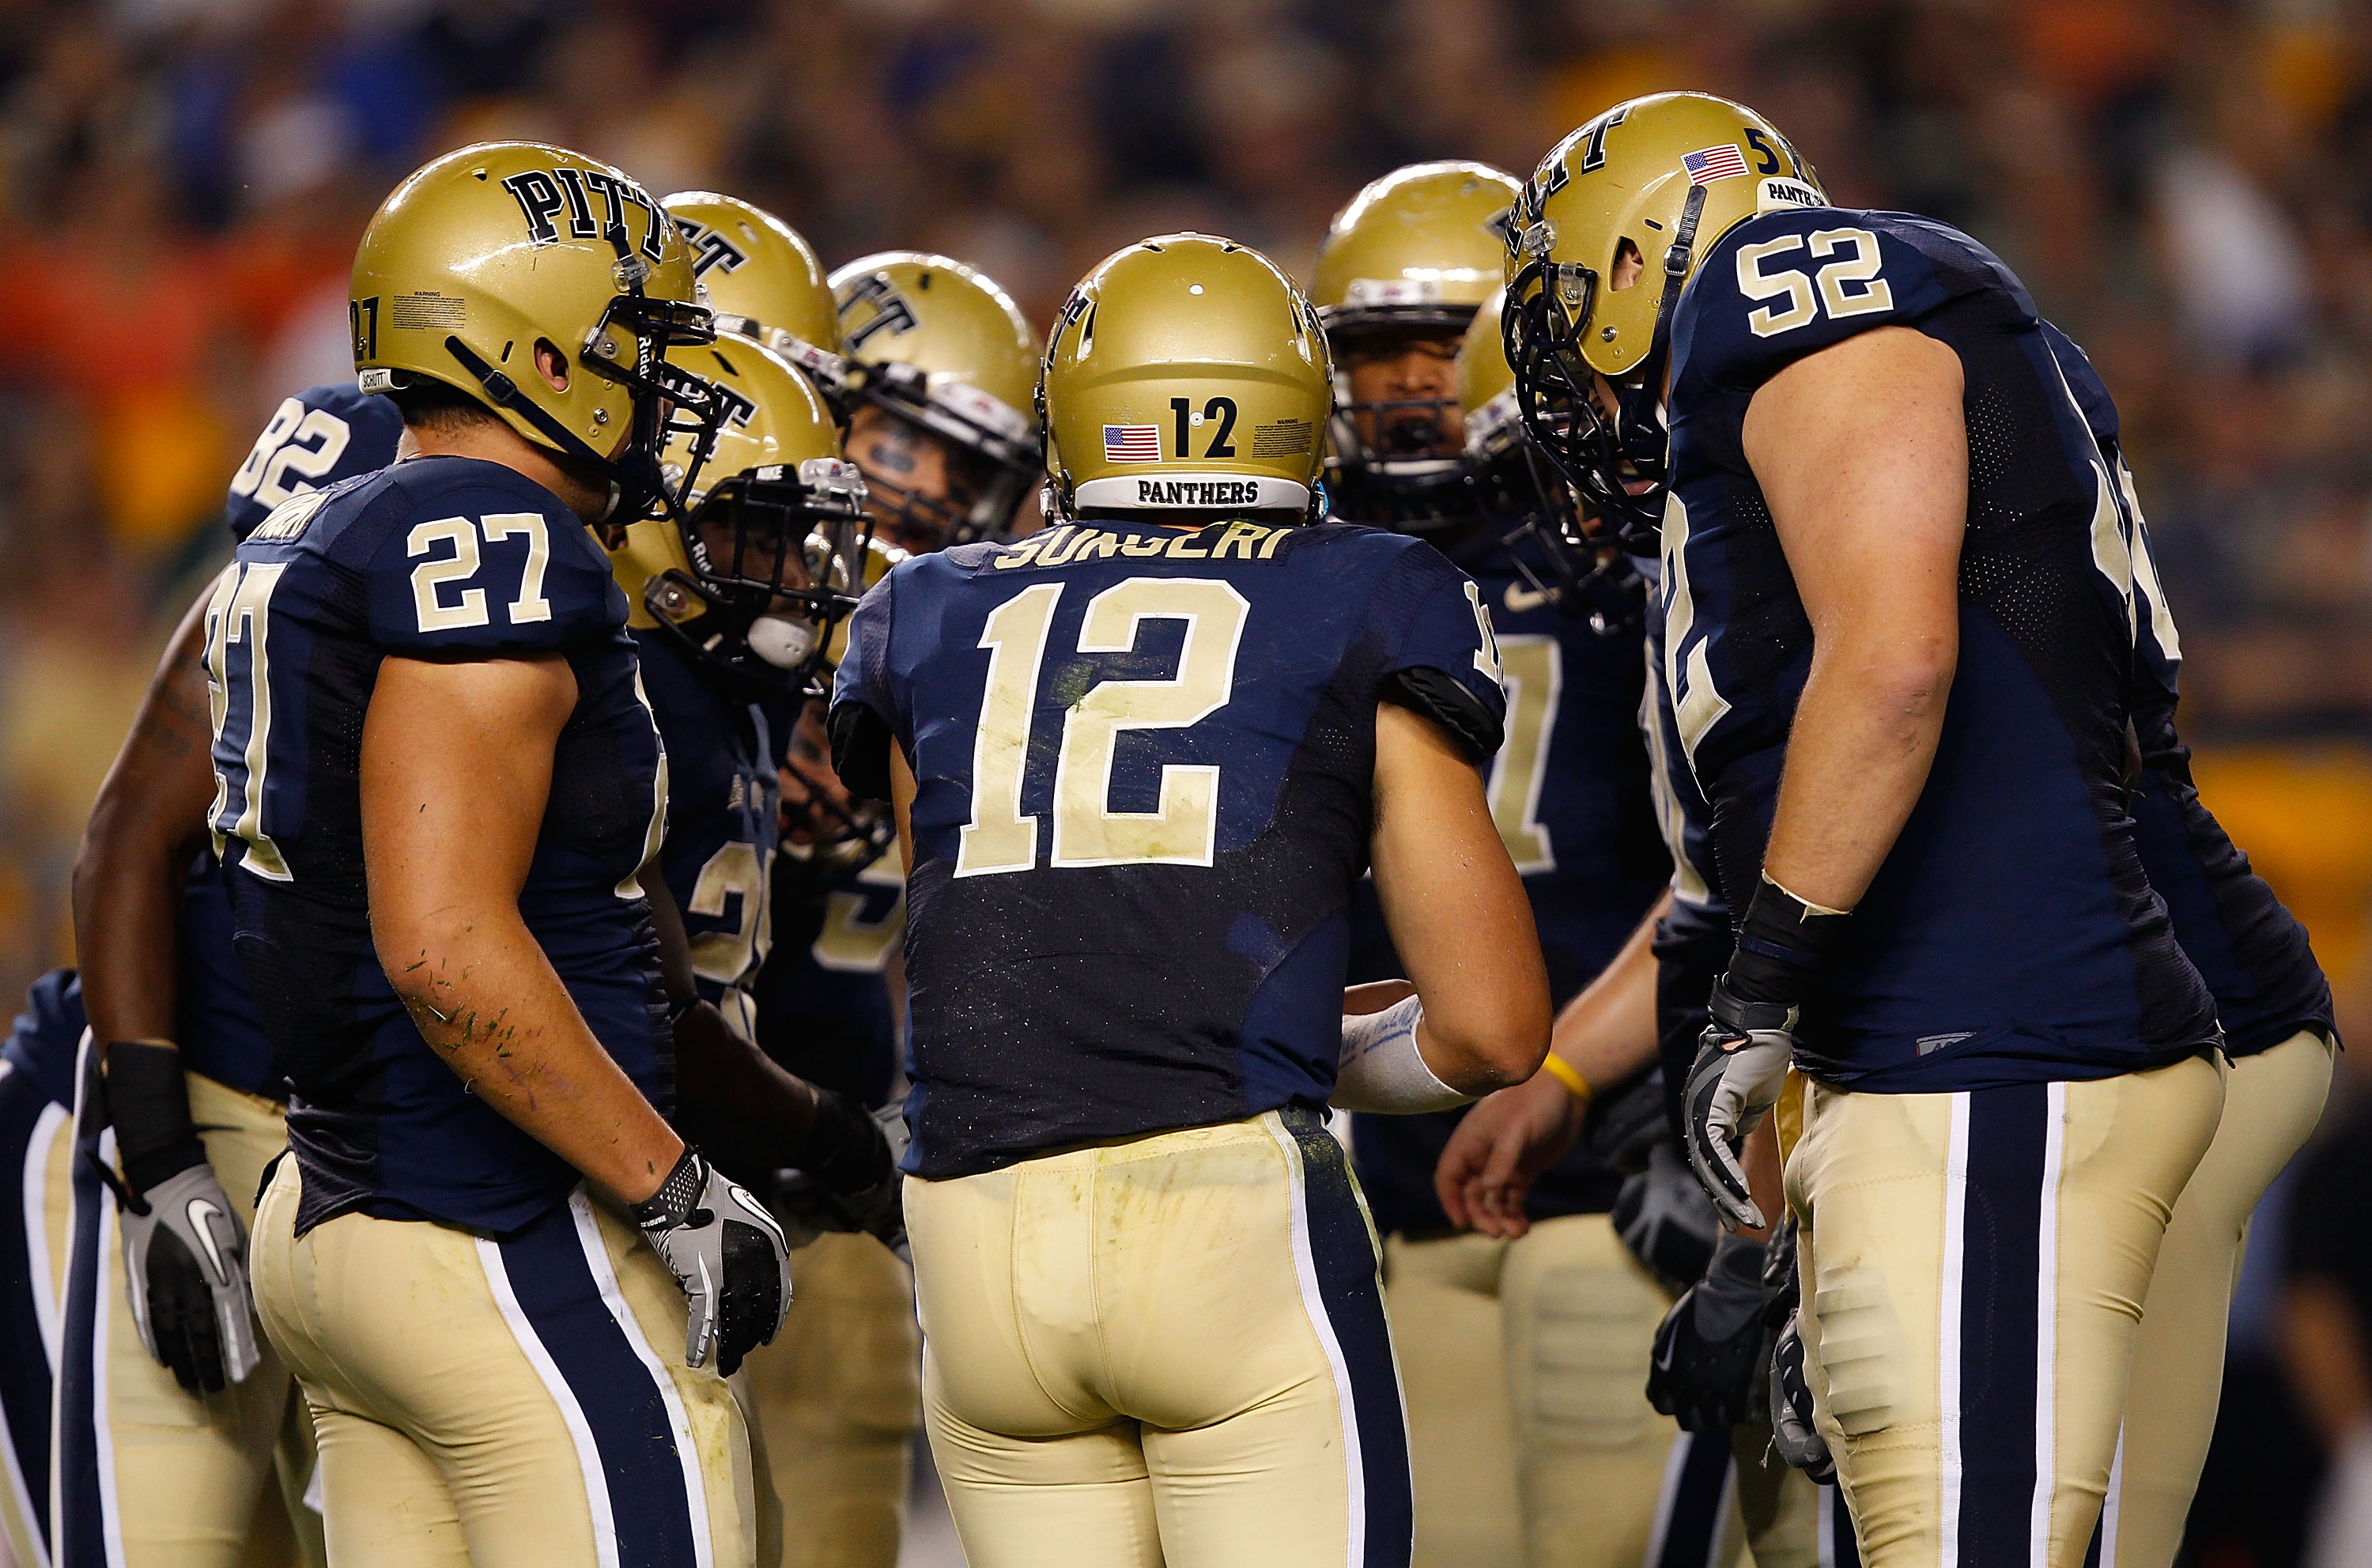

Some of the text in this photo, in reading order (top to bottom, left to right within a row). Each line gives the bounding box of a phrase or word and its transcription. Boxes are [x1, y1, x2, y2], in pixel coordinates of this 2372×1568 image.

[500, 168, 666, 265] PITT
[1736, 227, 1894, 338] 52
[229, 397, 351, 511] 82
[1170, 397, 1237, 458] 12
[1138, 480, 1259, 504] PANTHERS
[407, 512, 552, 632] 27
[953, 577, 1251, 878] 12
